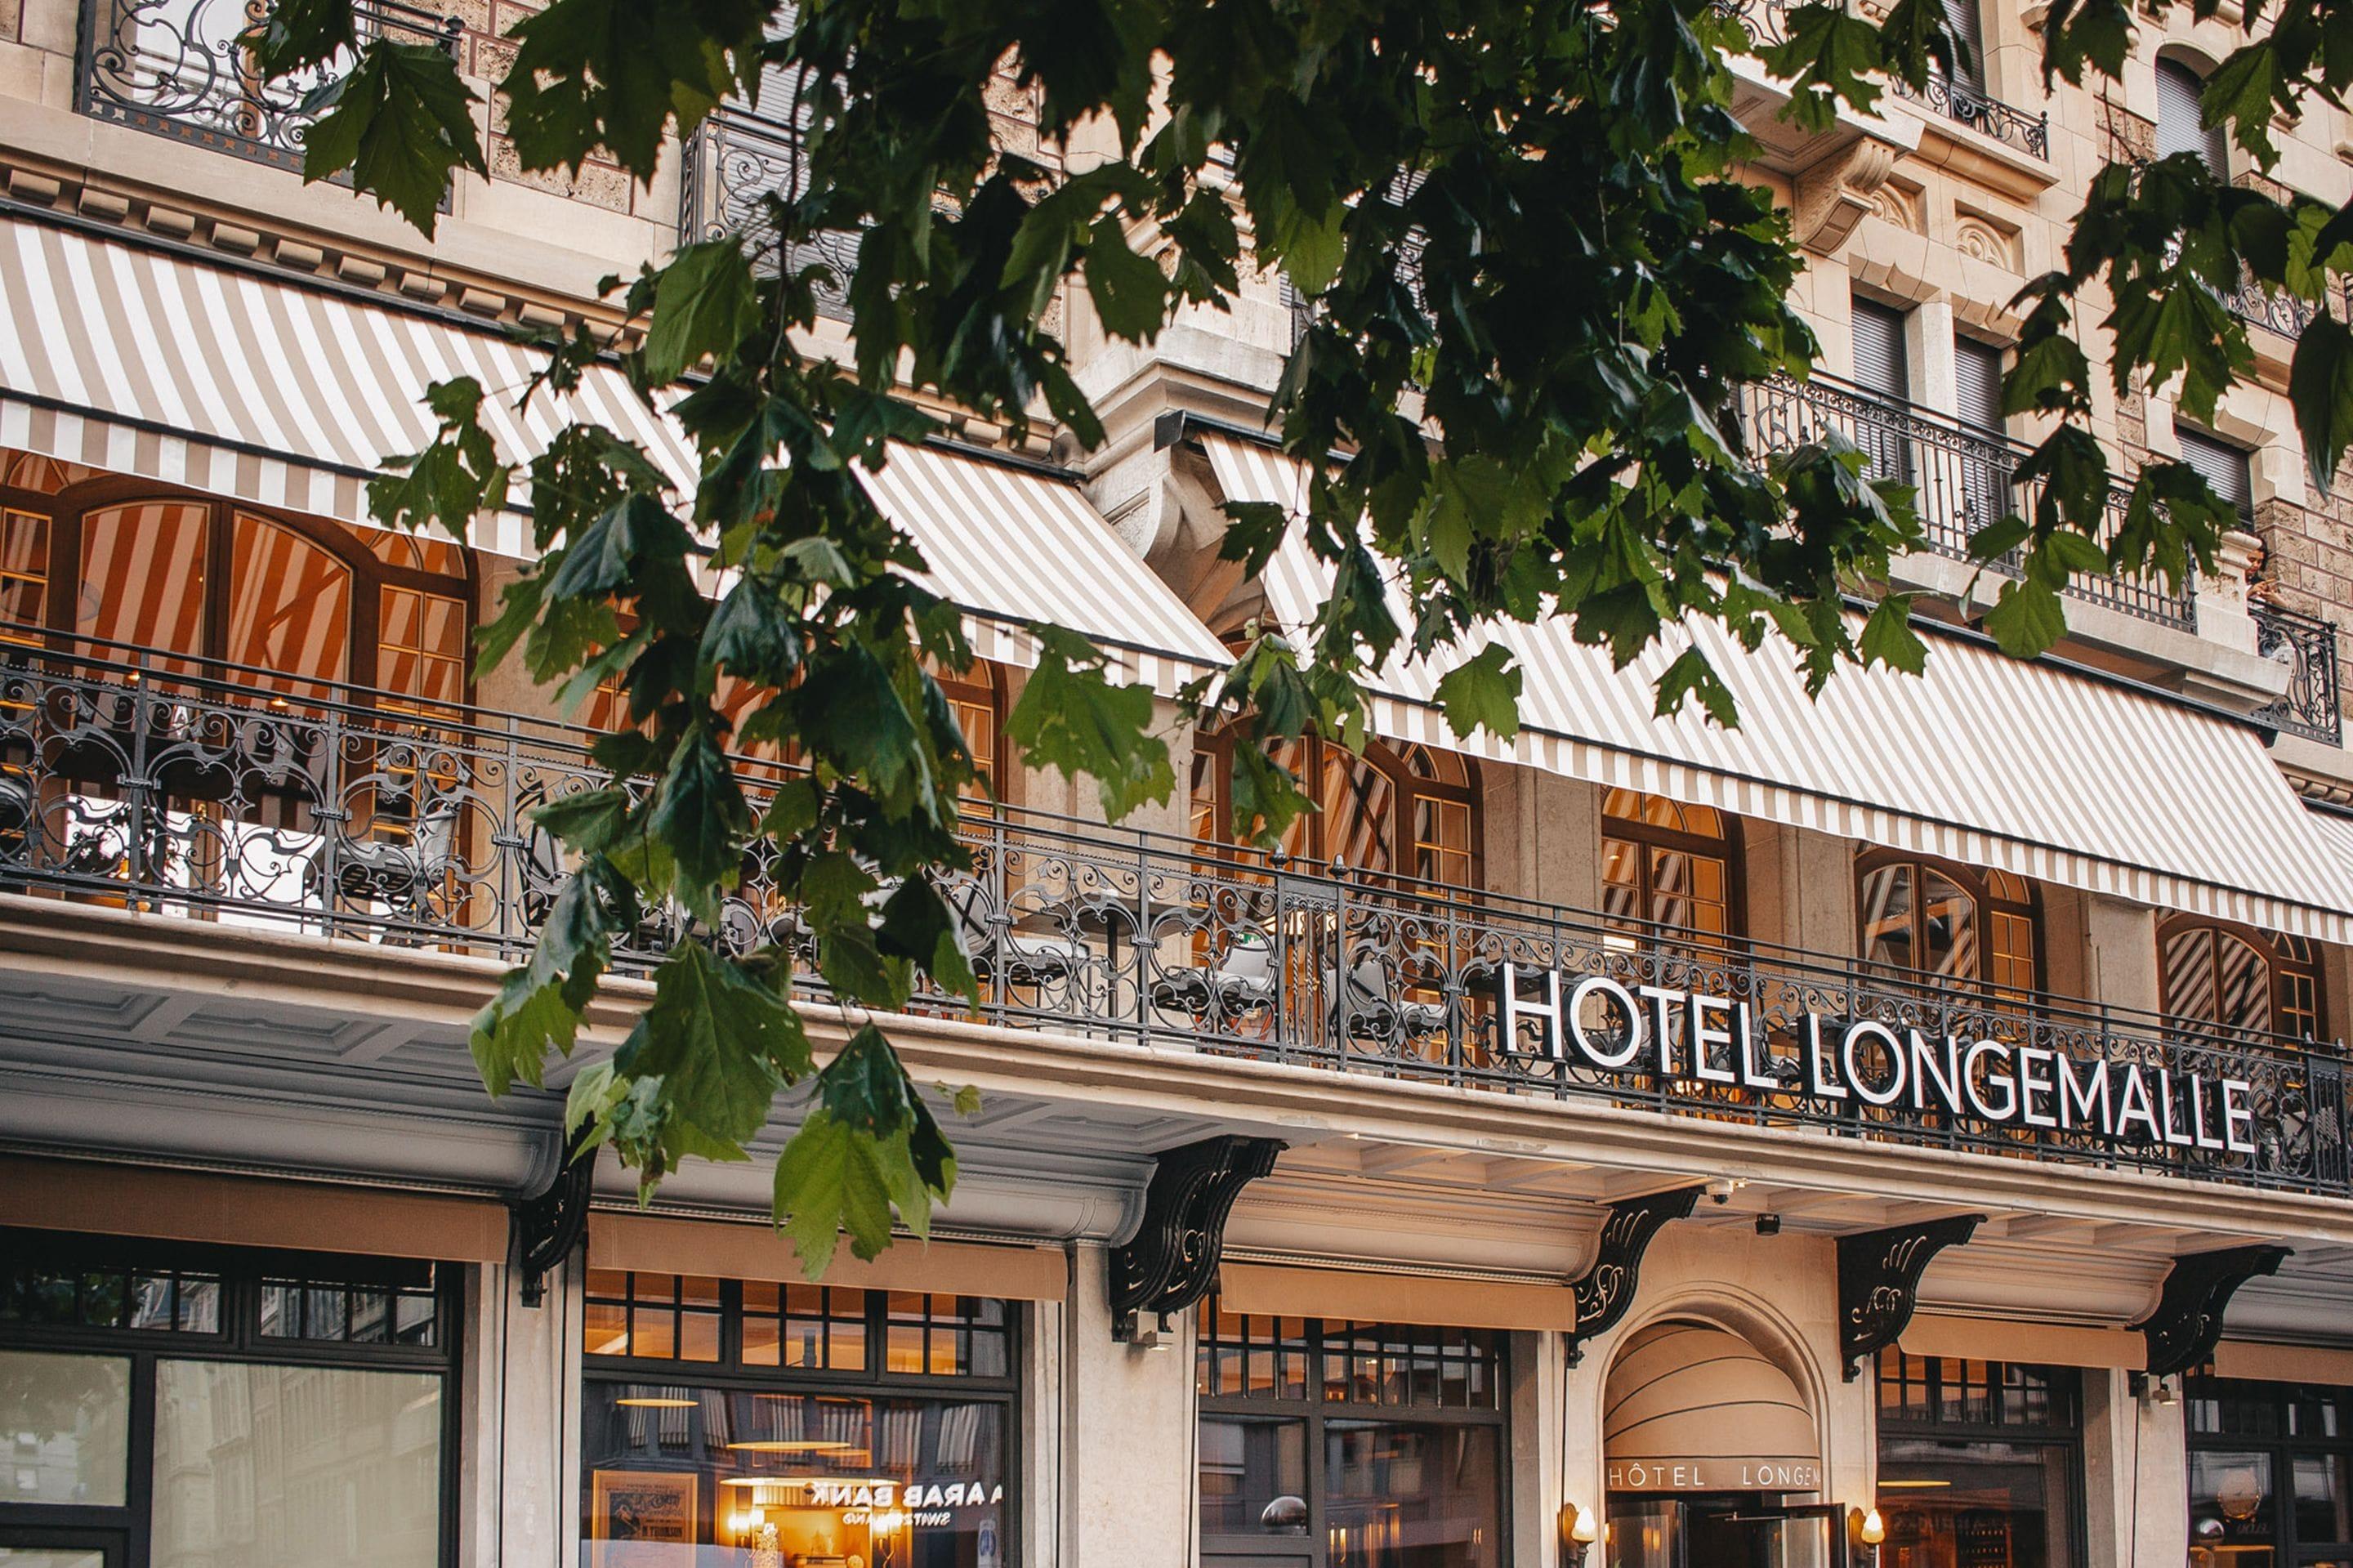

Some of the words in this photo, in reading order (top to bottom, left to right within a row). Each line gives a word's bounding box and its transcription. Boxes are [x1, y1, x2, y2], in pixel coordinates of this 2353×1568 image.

[1502, 963, 1779, 1089] HOTEL
[1808, 1012, 2256, 1154] LONGEMALLE
[1608, 1462, 1705, 1487] HÔTEL
